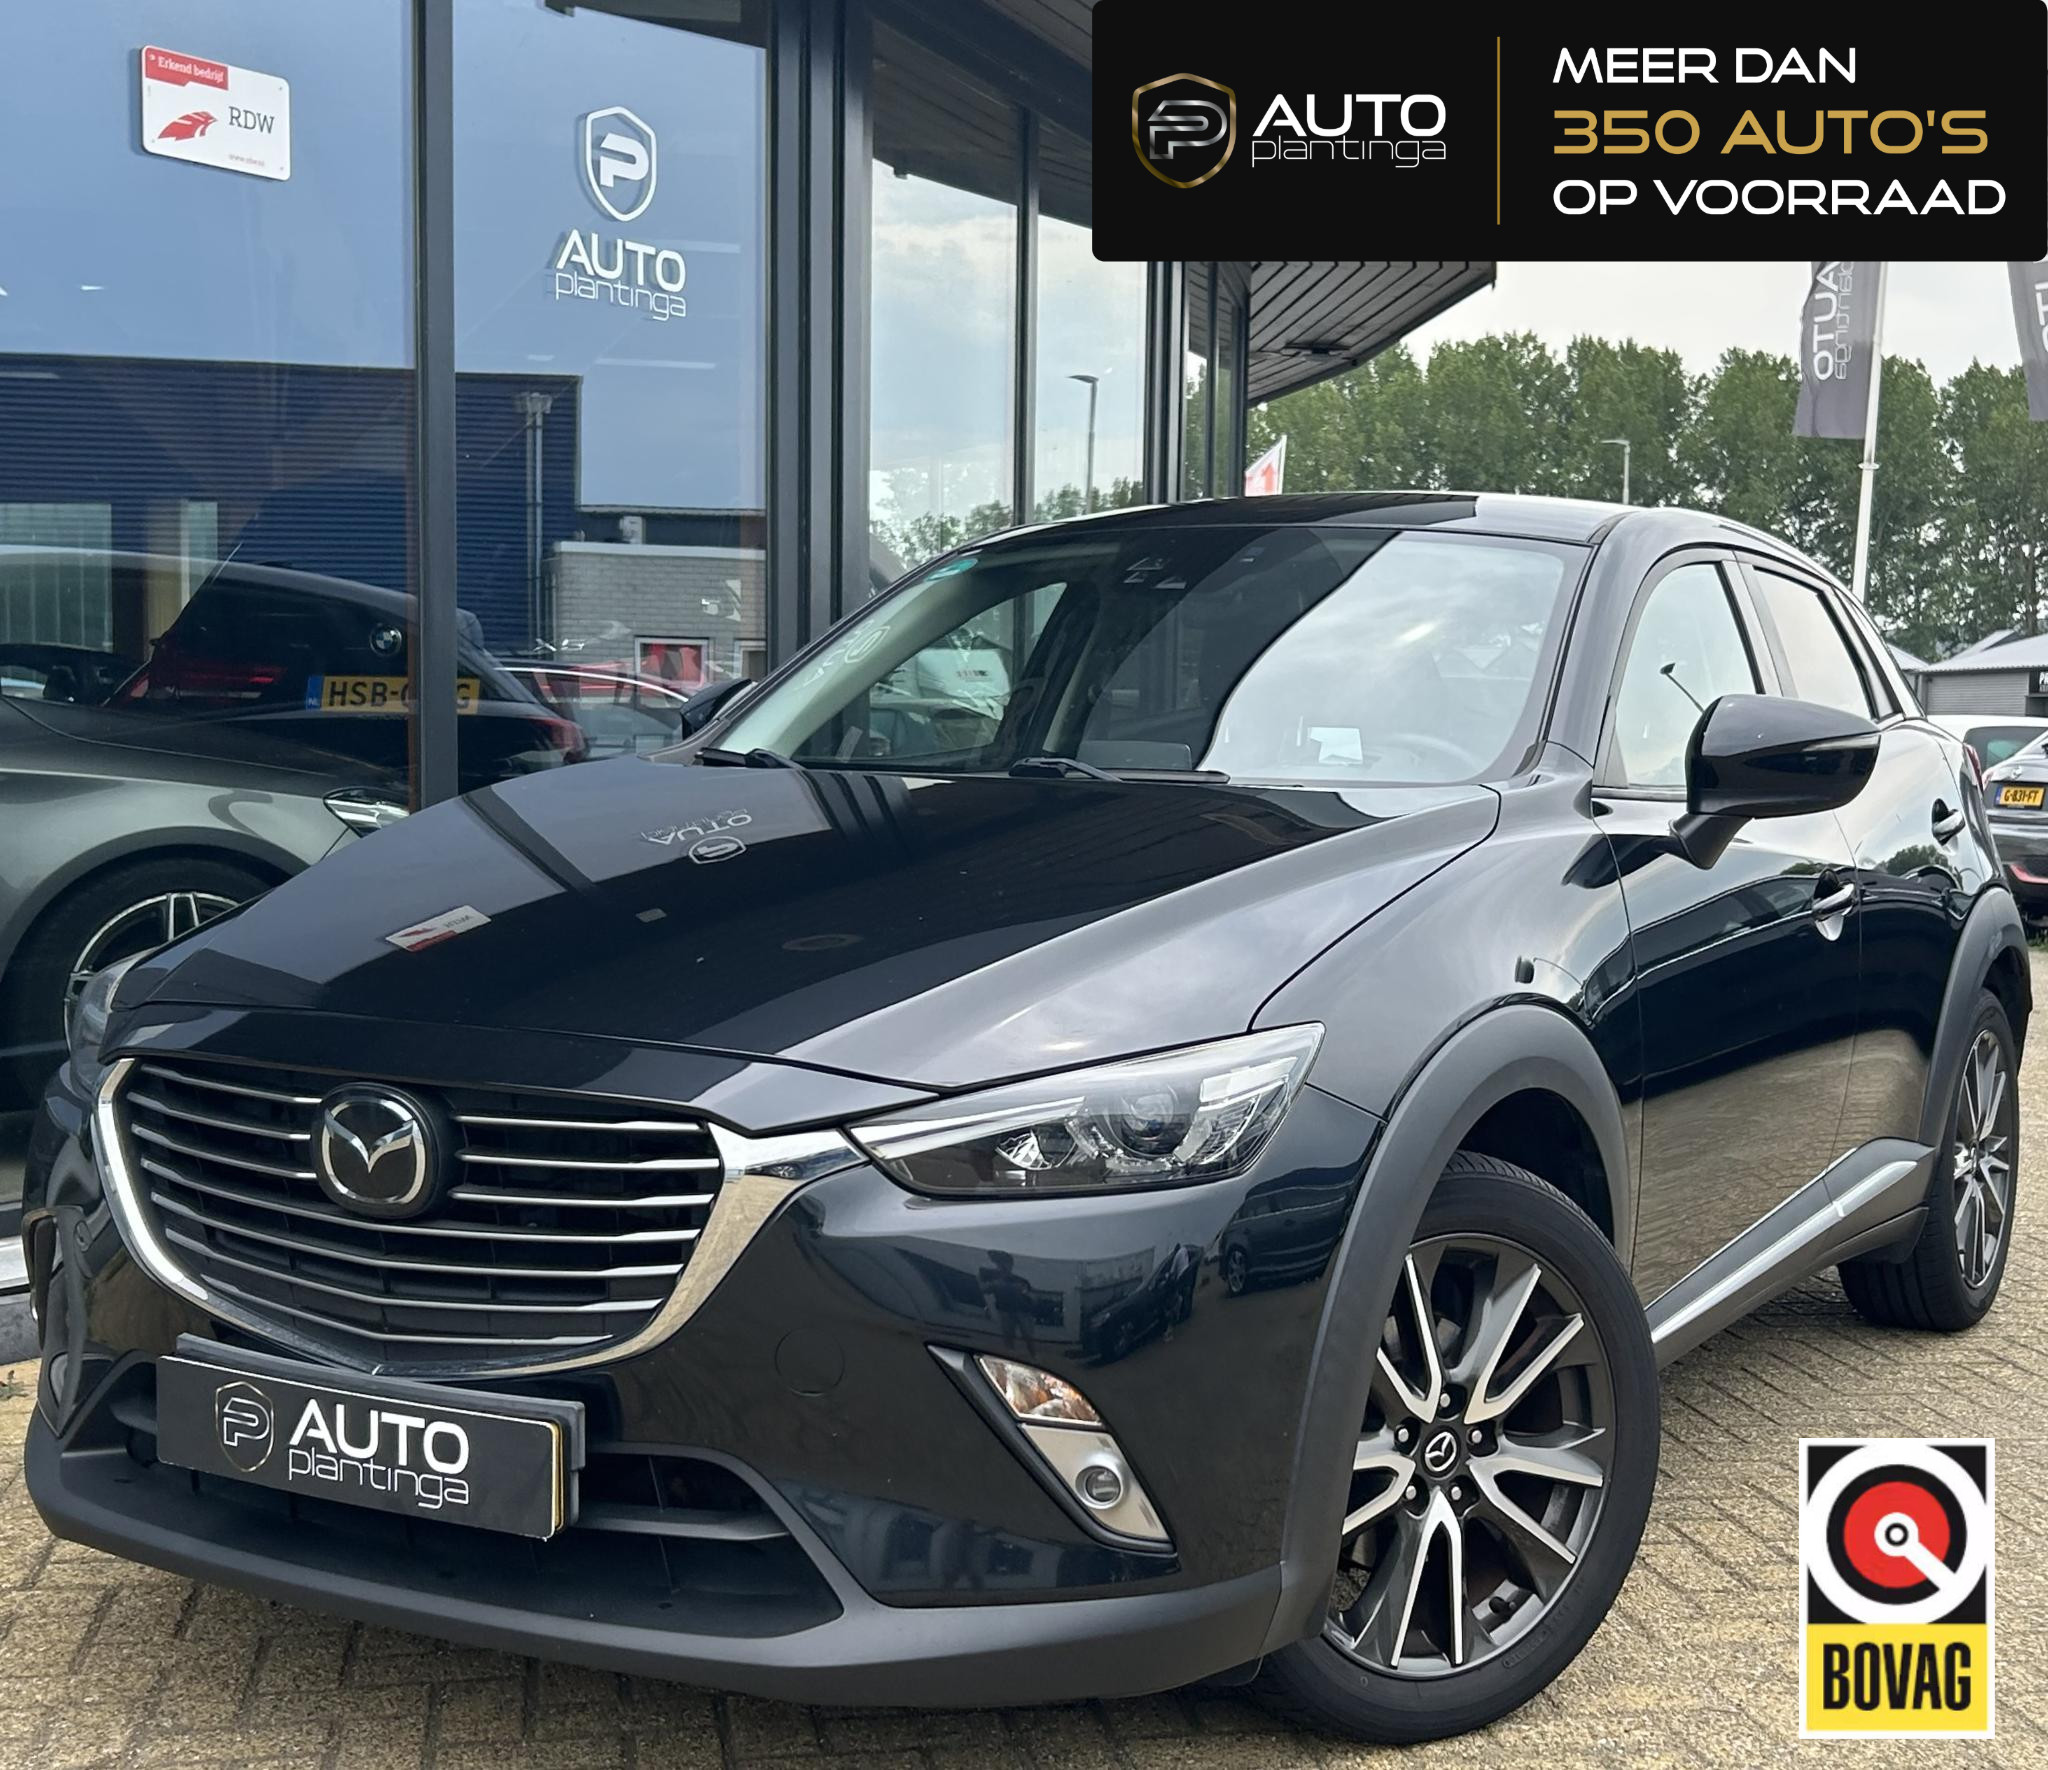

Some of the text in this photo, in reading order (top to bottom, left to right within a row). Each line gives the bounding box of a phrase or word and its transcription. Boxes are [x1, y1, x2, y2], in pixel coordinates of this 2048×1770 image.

[157, 56, 224, 84] Erkend bedrijf
[228, 106, 275, 134] RDW
[555, 228, 687, 293] AUTO
[555, 270, 687, 322] plantinga
[288, 1398, 470, 1475] AUTO
[288, 1448, 470, 1510] plantinga
